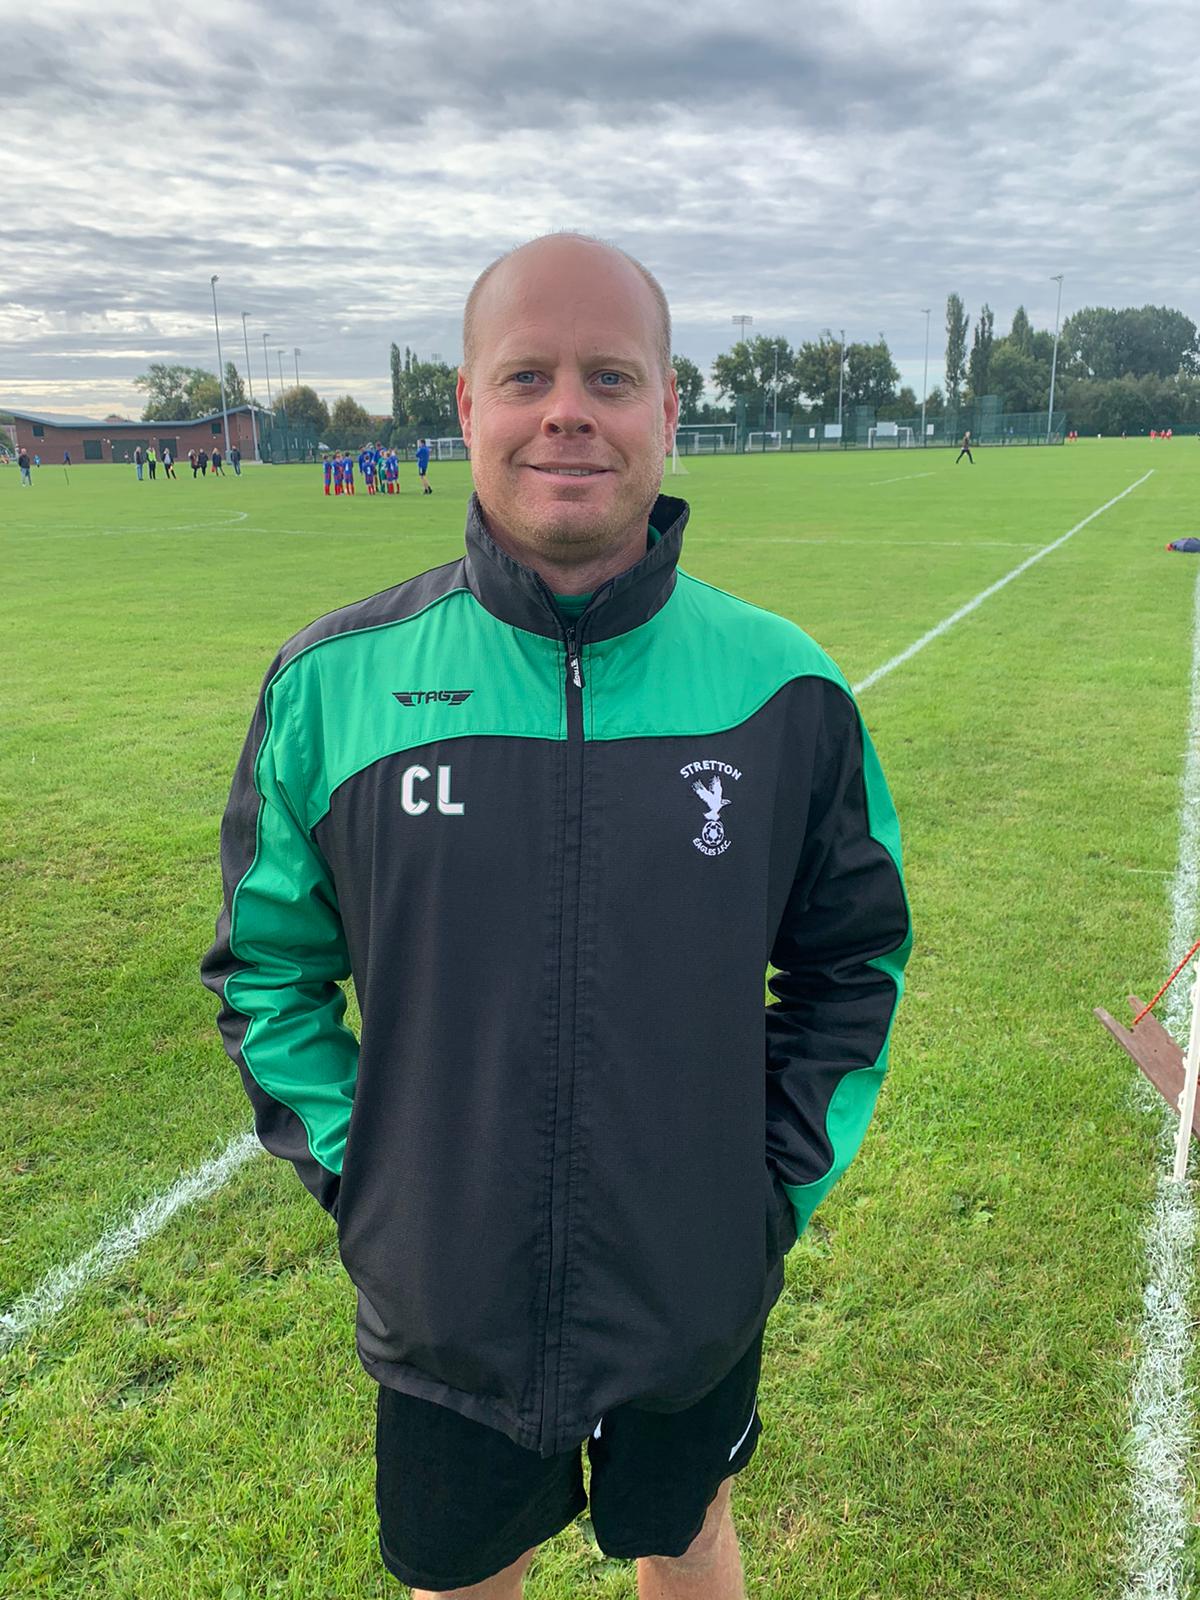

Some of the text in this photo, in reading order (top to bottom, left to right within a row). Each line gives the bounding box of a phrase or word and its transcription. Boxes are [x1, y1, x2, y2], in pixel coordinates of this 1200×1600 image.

[680, 760, 742, 780] STRETTON
[401, 764, 465, 816] CL
[693, 837, 716, 856] EAGLES
